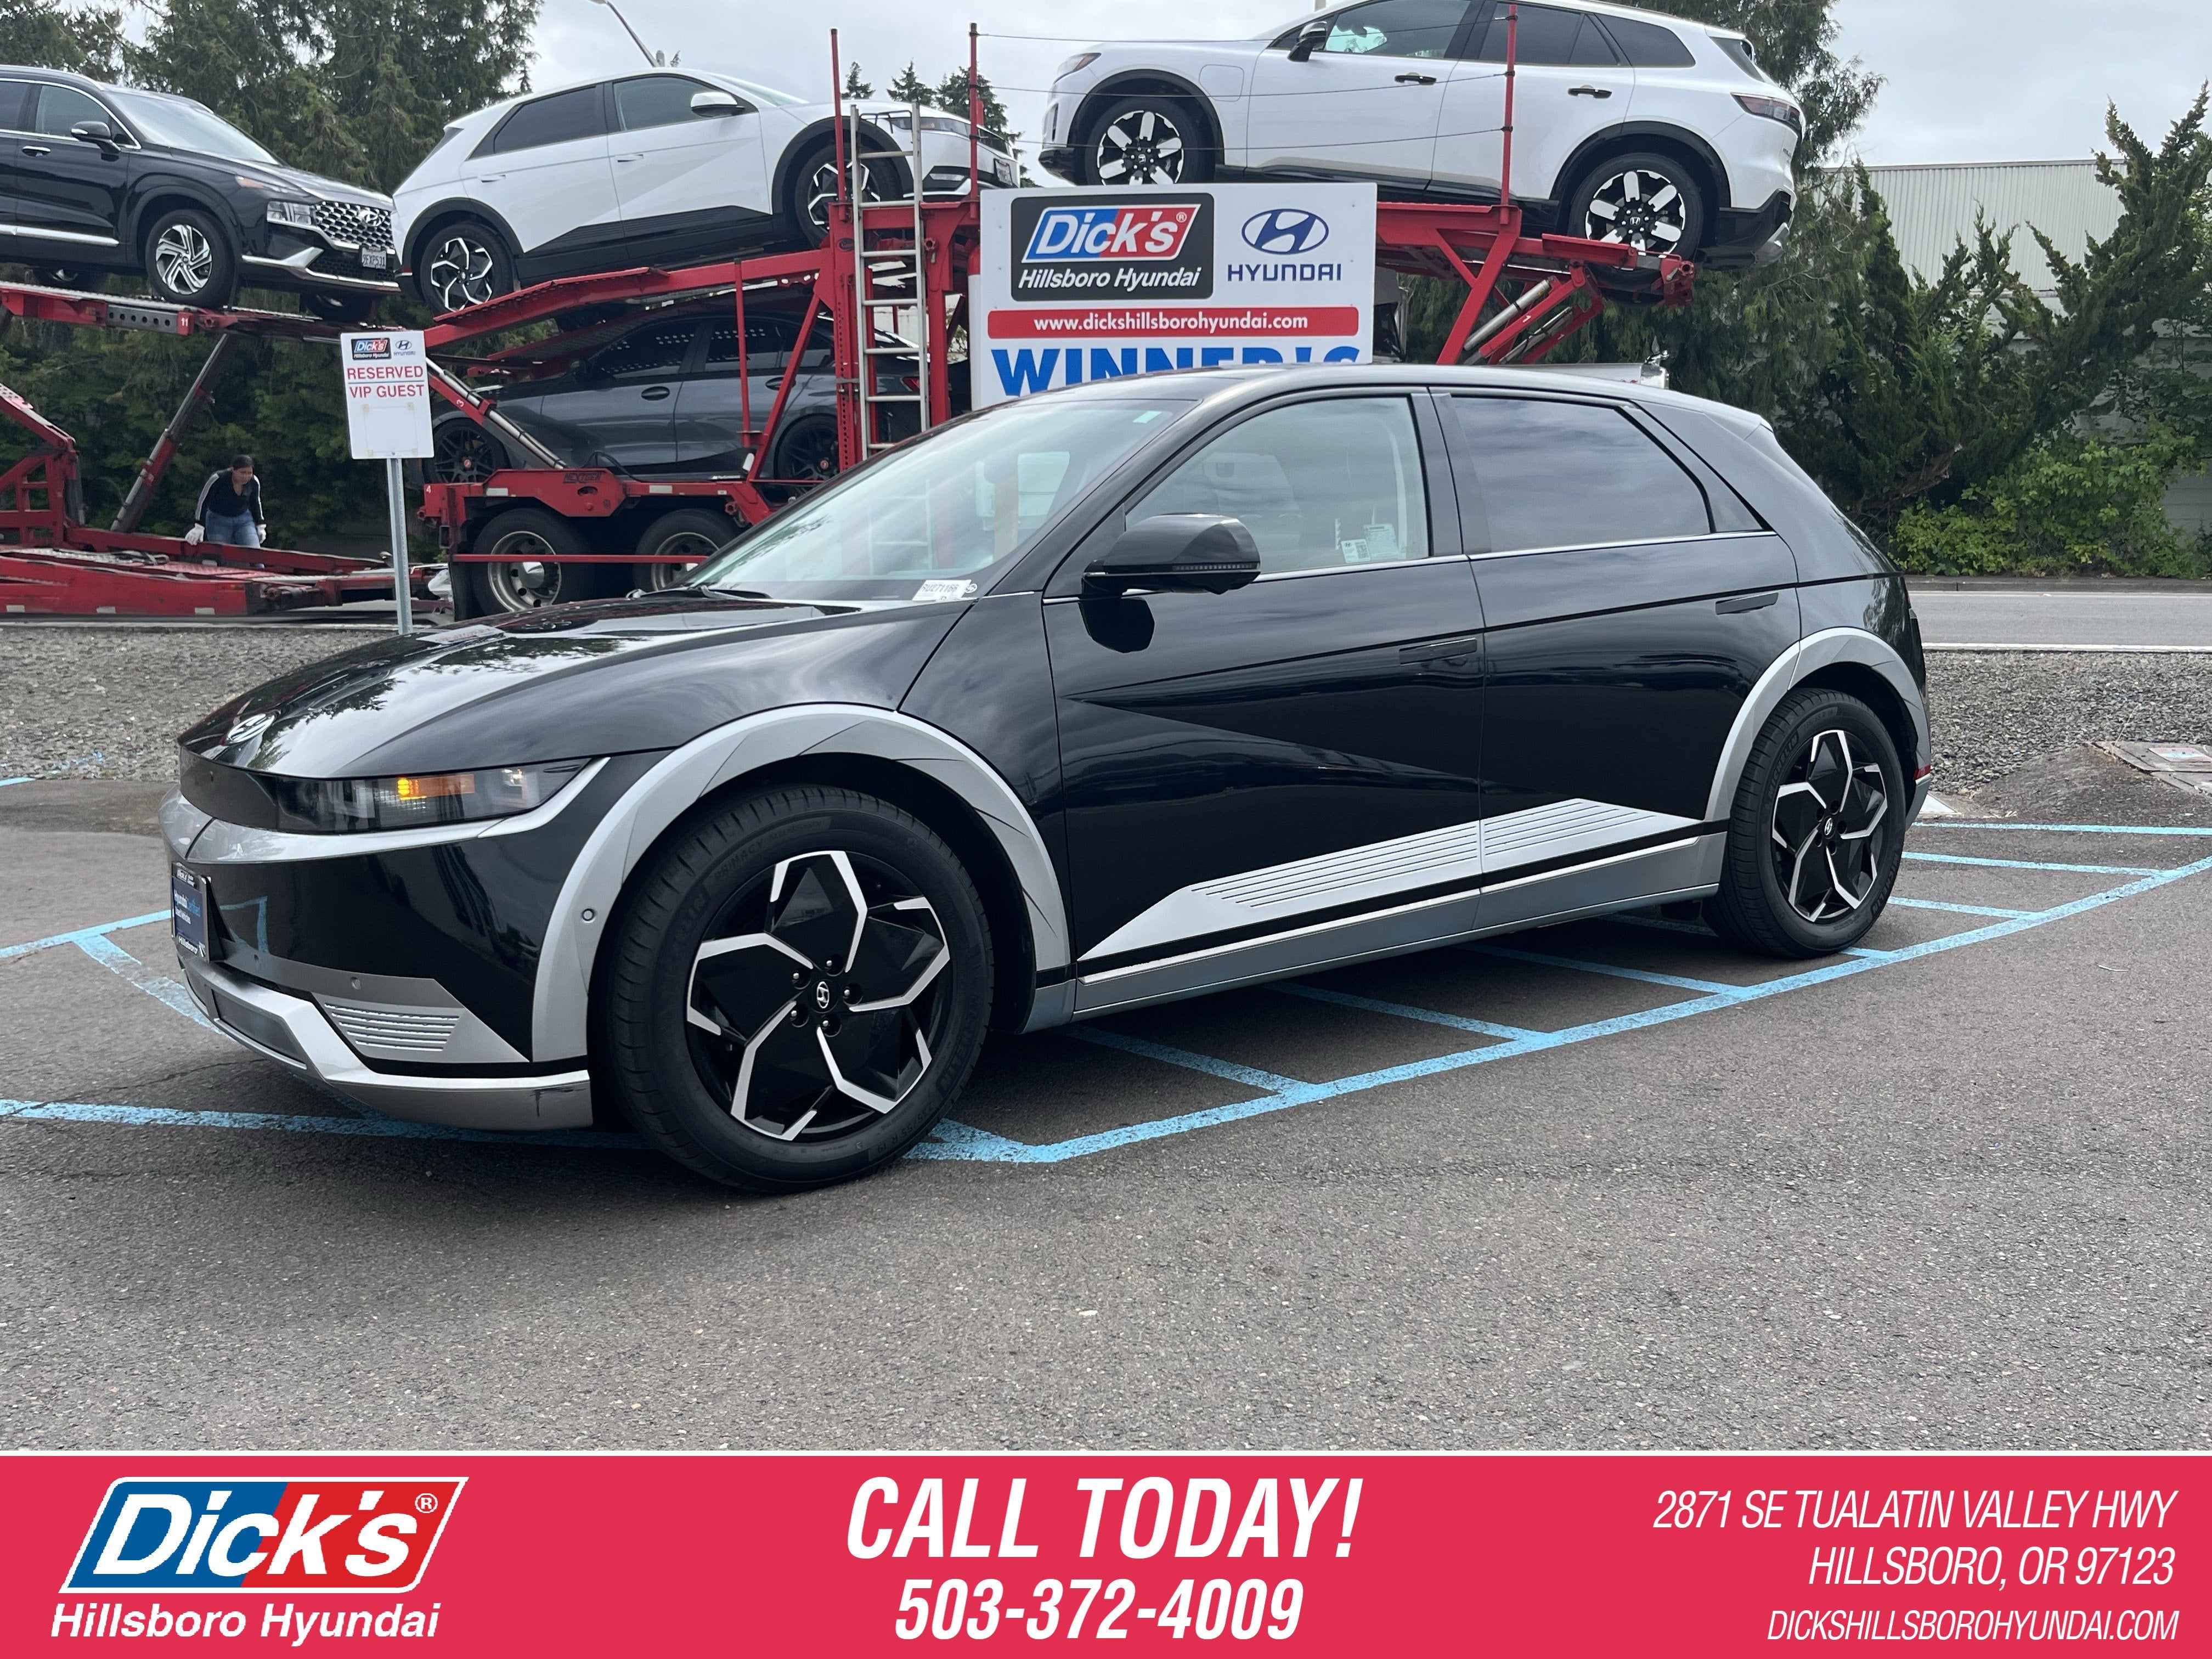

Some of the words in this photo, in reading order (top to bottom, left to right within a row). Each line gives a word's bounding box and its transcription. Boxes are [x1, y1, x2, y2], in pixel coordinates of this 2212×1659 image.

[1036, 211, 1177, 255] Dick's
[1228, 263, 1341, 281] HYUNDAI
[1019, 269, 1110, 290] Hillsboro
[1114, 267, 1201, 292] Hyundai
[181, 318, 188, 326] 11
[1034, 311, 1308, 334] www.dickshillsborohyundai.com
[347, 366, 424, 380] RESERVED
[349, 386, 371, 398] VIP
[376, 385, 425, 398] GUEST
[456, 399, 465, 408] 3
[426, 484, 432, 493] 4
